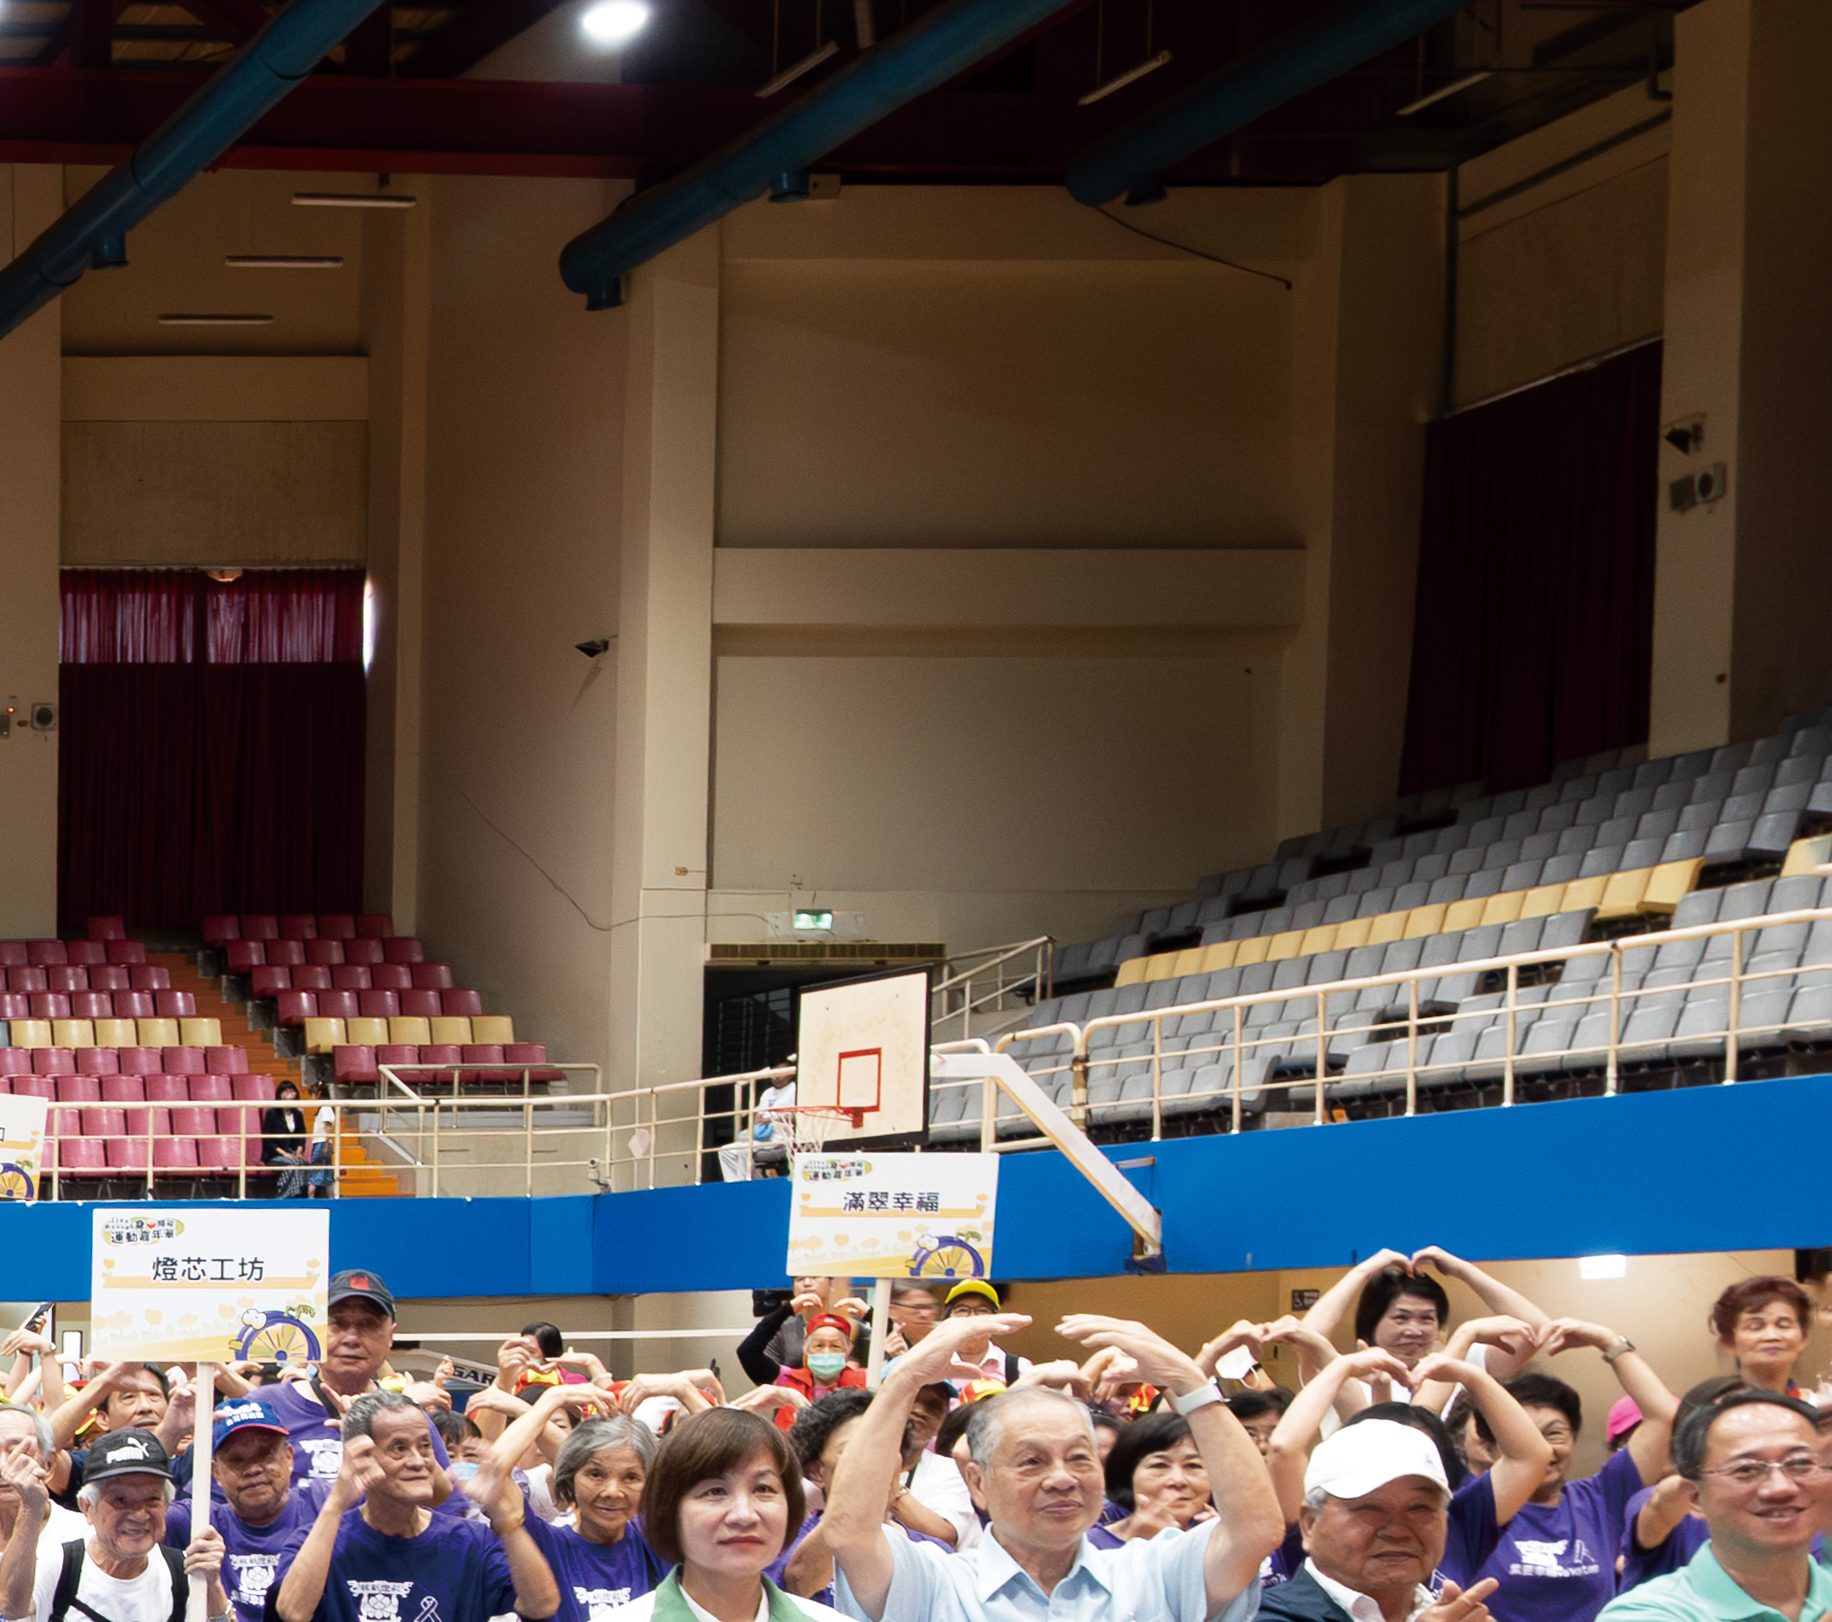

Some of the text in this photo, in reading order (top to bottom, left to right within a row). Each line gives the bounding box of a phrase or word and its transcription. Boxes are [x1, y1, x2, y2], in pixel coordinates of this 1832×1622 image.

[843, 1192, 940, 1212] 滿翠幸福
[152, 1256, 265, 1281] 燈芯工坊
